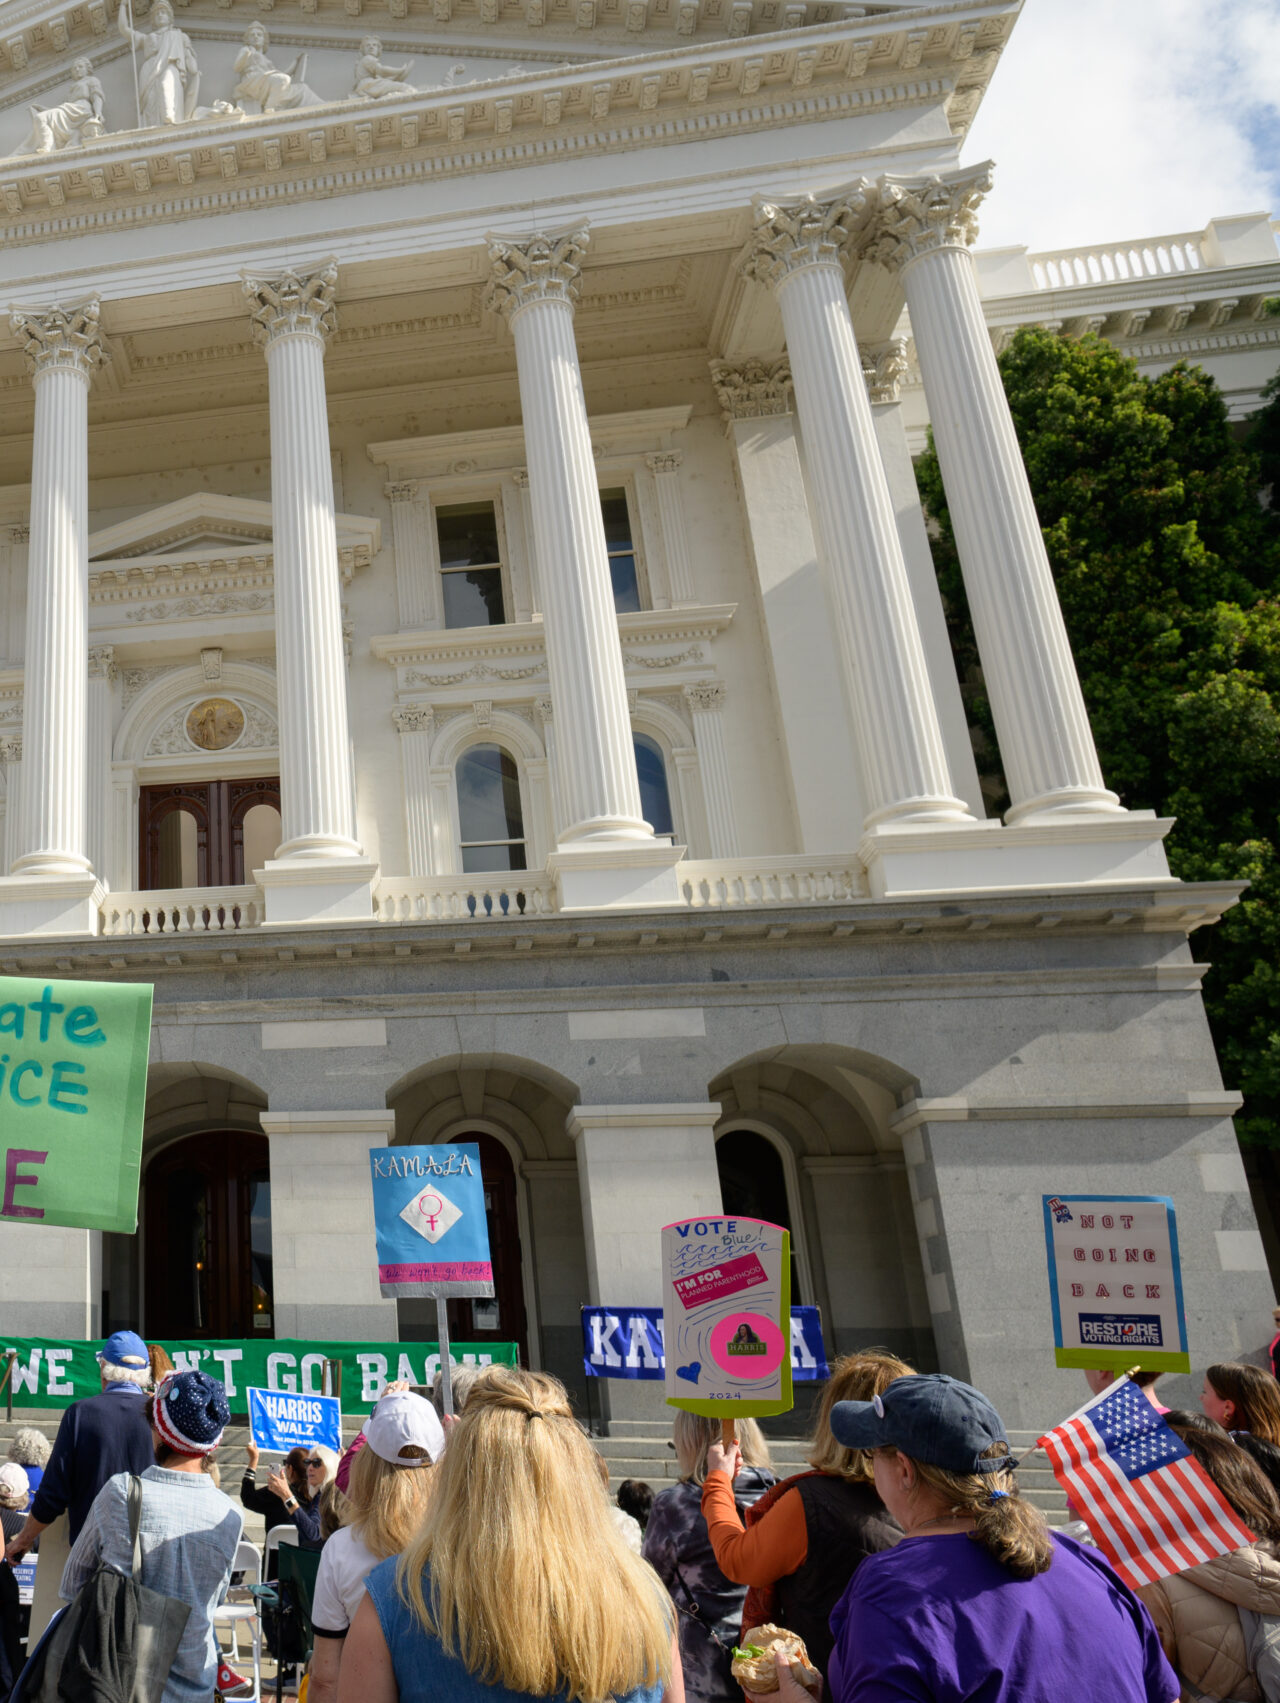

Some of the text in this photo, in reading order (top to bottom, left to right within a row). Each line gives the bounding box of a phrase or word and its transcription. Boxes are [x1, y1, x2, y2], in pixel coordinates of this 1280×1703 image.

[374, 1153, 474, 1178] KAMALA
[675, 1221, 737, 1238] VOTE
[1080, 1214, 1133, 1229] NOT
[722, 1225, 764, 1246] Blue!
[1073, 1247, 1156, 1262] GOING
[445, 1267, 457, 1280] go
[676, 1268, 723, 1293] I'M FOR
[680, 1283, 714, 1299] PLANNED
[713, 1265, 762, 1288] PARENTHOOD
[1071, 1283, 1160, 1298] BACK
[1081, 1321, 1160, 1336] RESTORE
[590, 1315, 817, 1369] KAA
[1082, 1333, 1160, 1345] VOTING RIGHTS
[6, 1348, 73, 1395] WE
[267, 1352, 332, 1397] GO
[357, 1353, 492, 1401] BAC
[709, 1391, 742, 1400] 2024
[266, 1396, 322, 1423] HARRIS
[276, 1420, 315, 1436] WALZ
